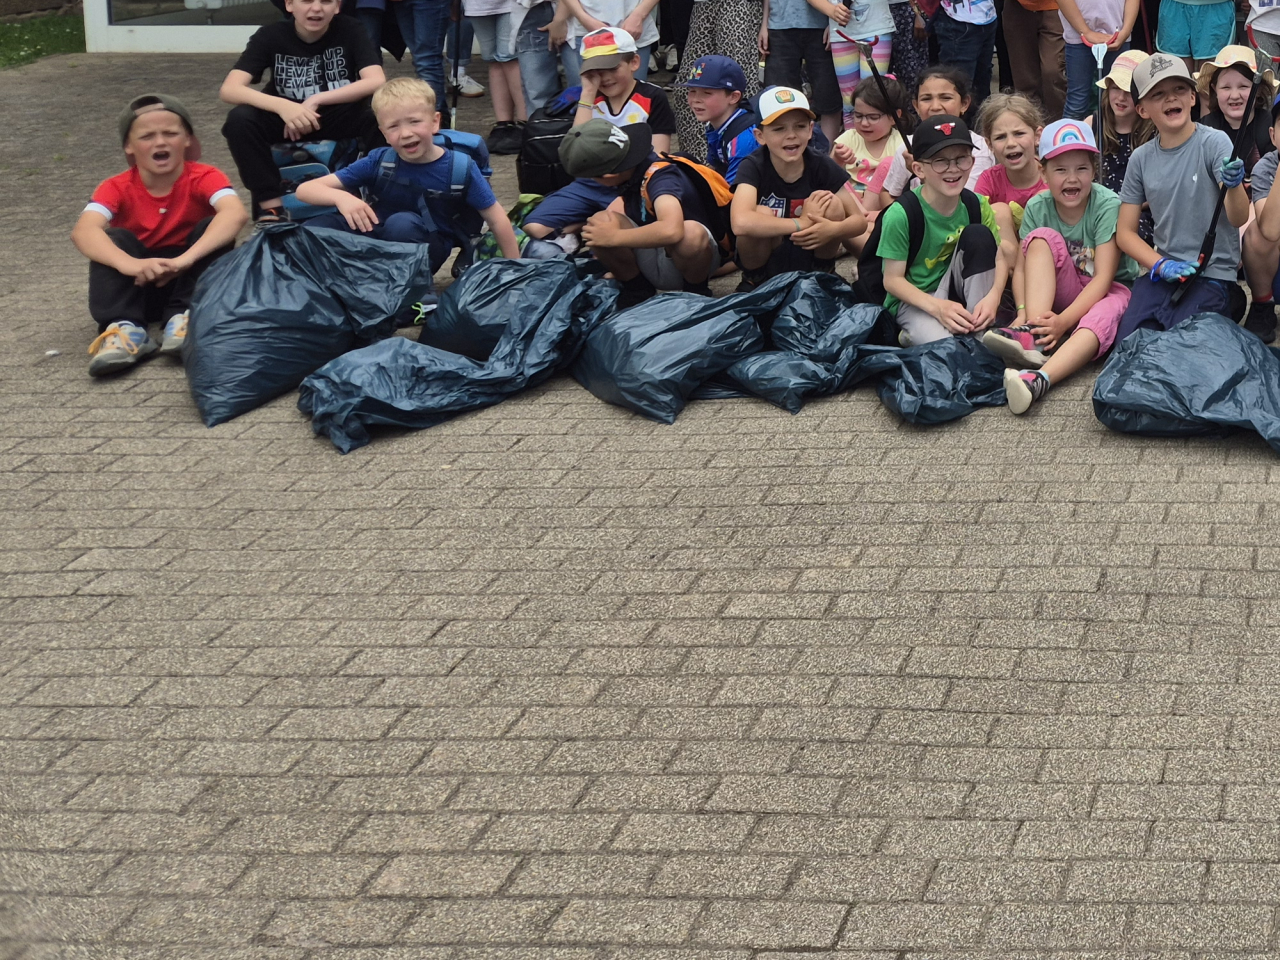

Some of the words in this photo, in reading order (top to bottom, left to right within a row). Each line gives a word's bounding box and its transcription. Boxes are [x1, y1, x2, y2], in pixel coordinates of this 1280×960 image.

[274, 53, 321, 68] LEVEL
[322, 46, 344, 62] UP
[274, 64, 322, 78] LEVEL
[324, 57, 346, 72] UP
[274, 76, 324, 89] LEVEL
[324, 68, 349, 83] UP
